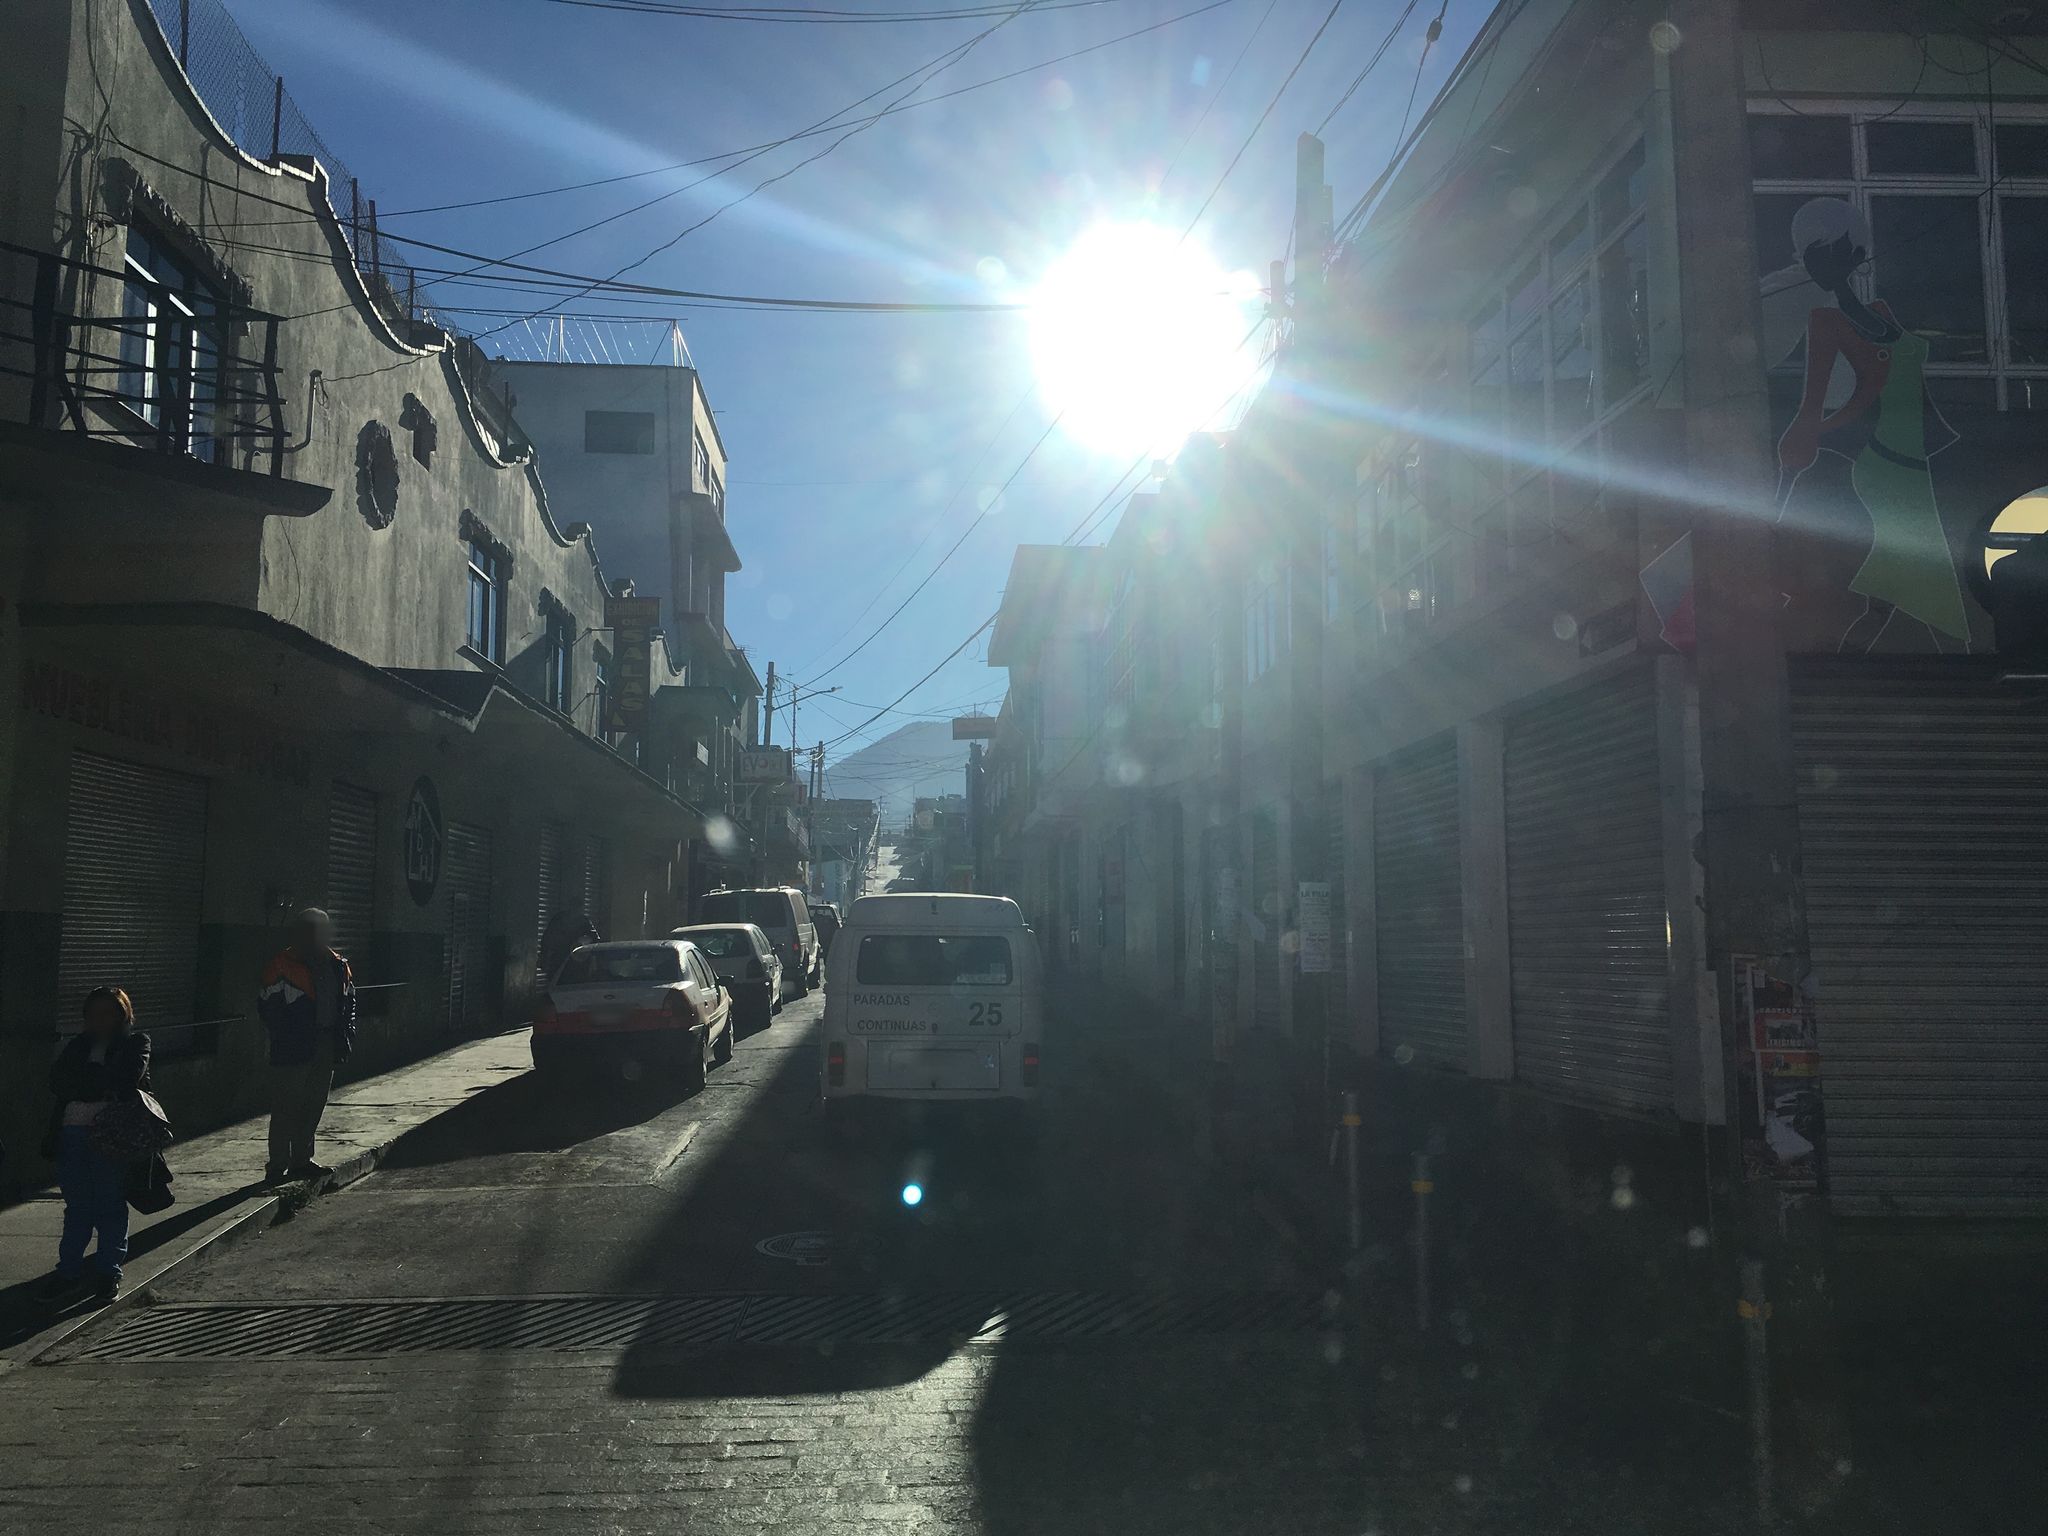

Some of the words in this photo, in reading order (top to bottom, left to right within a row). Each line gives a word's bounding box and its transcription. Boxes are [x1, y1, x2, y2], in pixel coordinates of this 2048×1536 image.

[853, 994, 911, 1006] PARADAS
[968, 1001, 1003, 1027] 25
[856, 1019, 927, 1031] CONTINUAS
